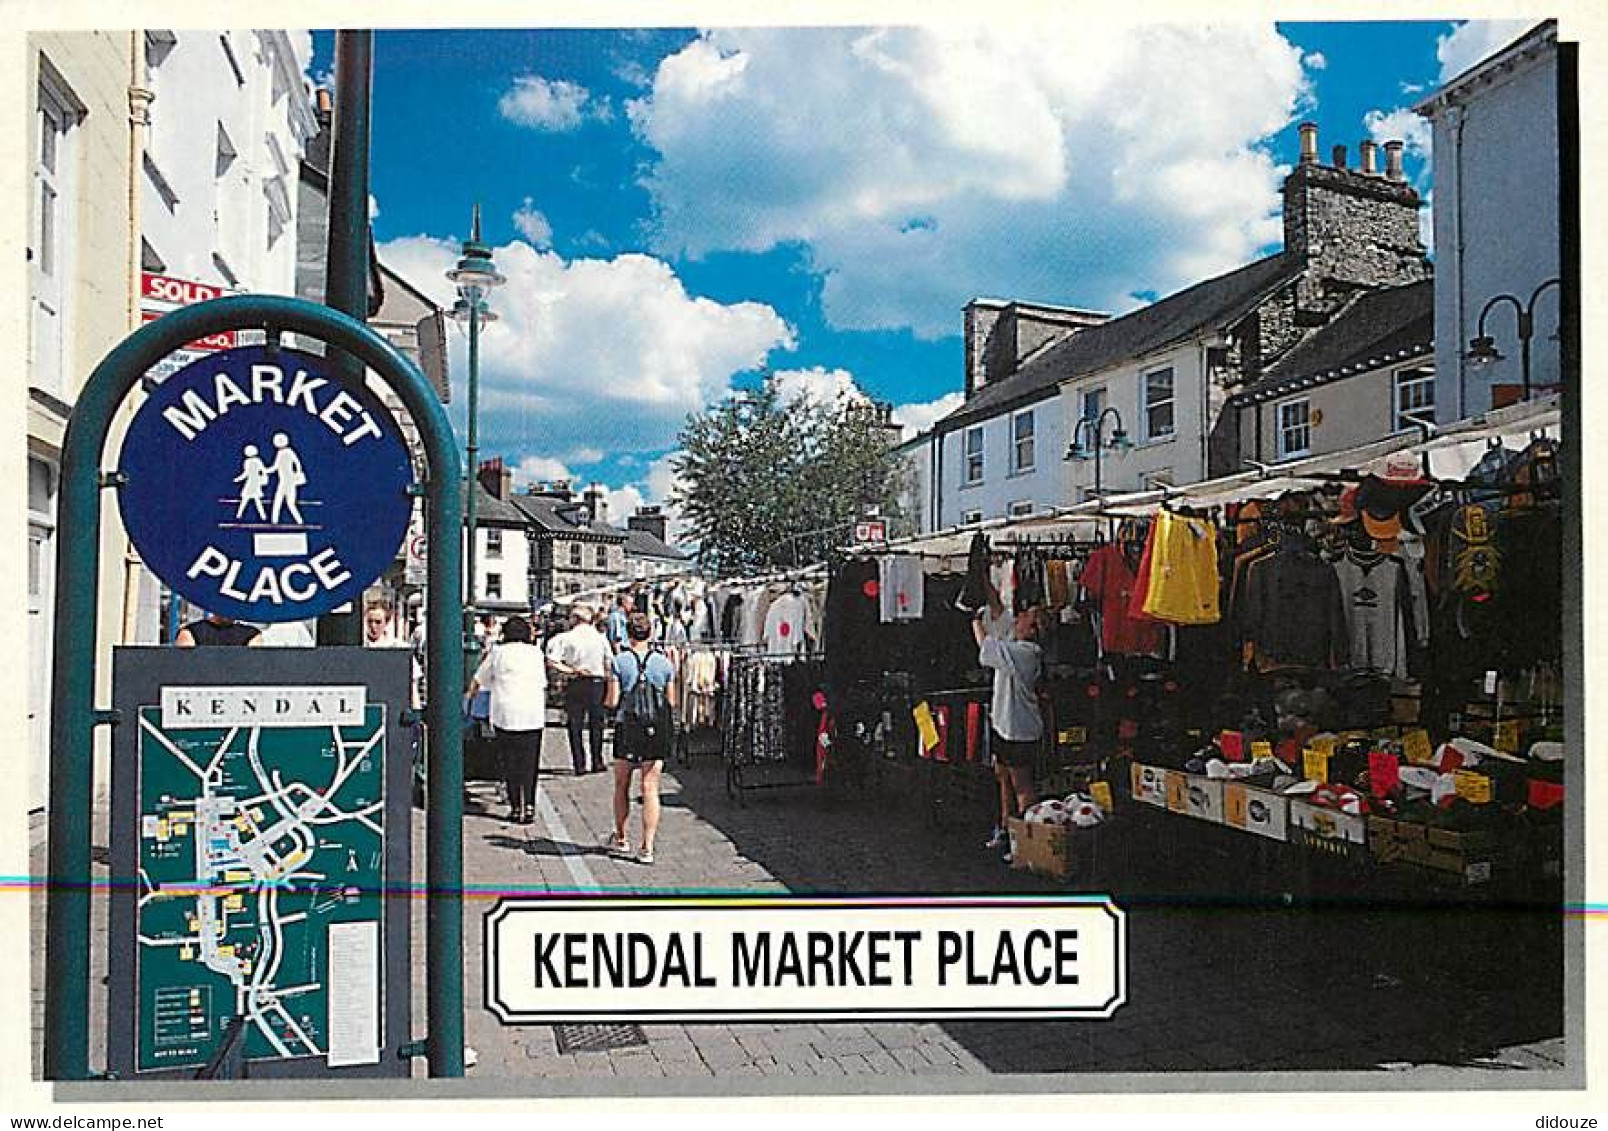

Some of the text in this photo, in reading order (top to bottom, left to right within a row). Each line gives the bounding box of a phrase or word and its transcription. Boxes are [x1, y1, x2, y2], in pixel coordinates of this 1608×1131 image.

[150, 277, 214, 302] SOLD
[163, 364, 382, 446] MARKET
[187, 547, 351, 603] PLACE
[177, 698, 355, 716] KENDAL
